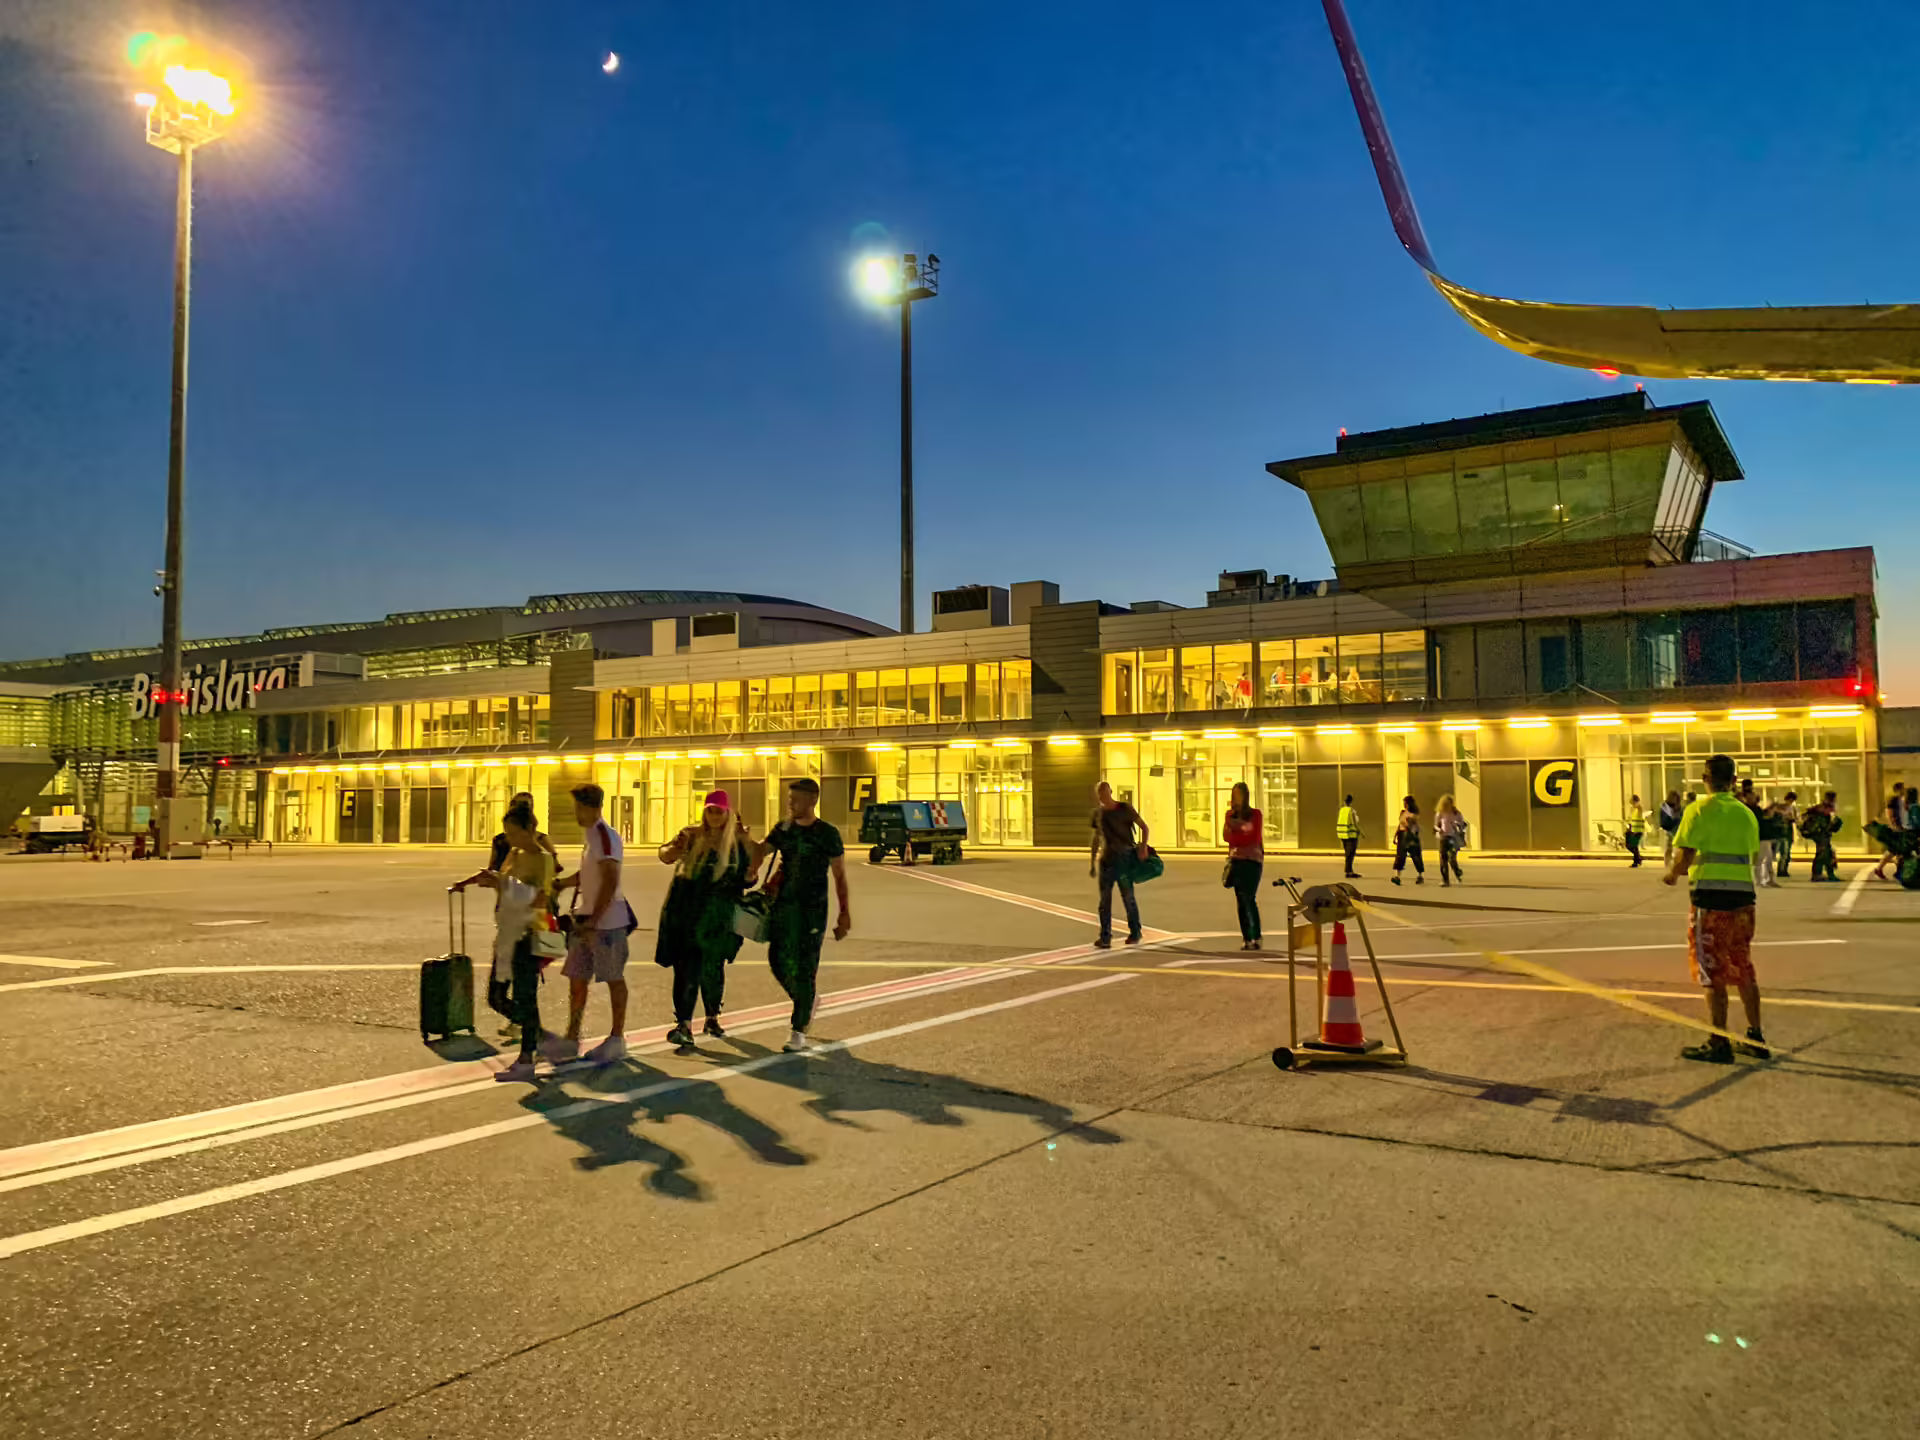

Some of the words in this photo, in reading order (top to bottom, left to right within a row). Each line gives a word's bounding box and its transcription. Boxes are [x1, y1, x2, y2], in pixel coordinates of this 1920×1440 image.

[131, 659, 285, 719] Brtislava
[852, 777, 873, 811] F
[1534, 761, 1575, 805] G
[342, 791, 354, 816] E
